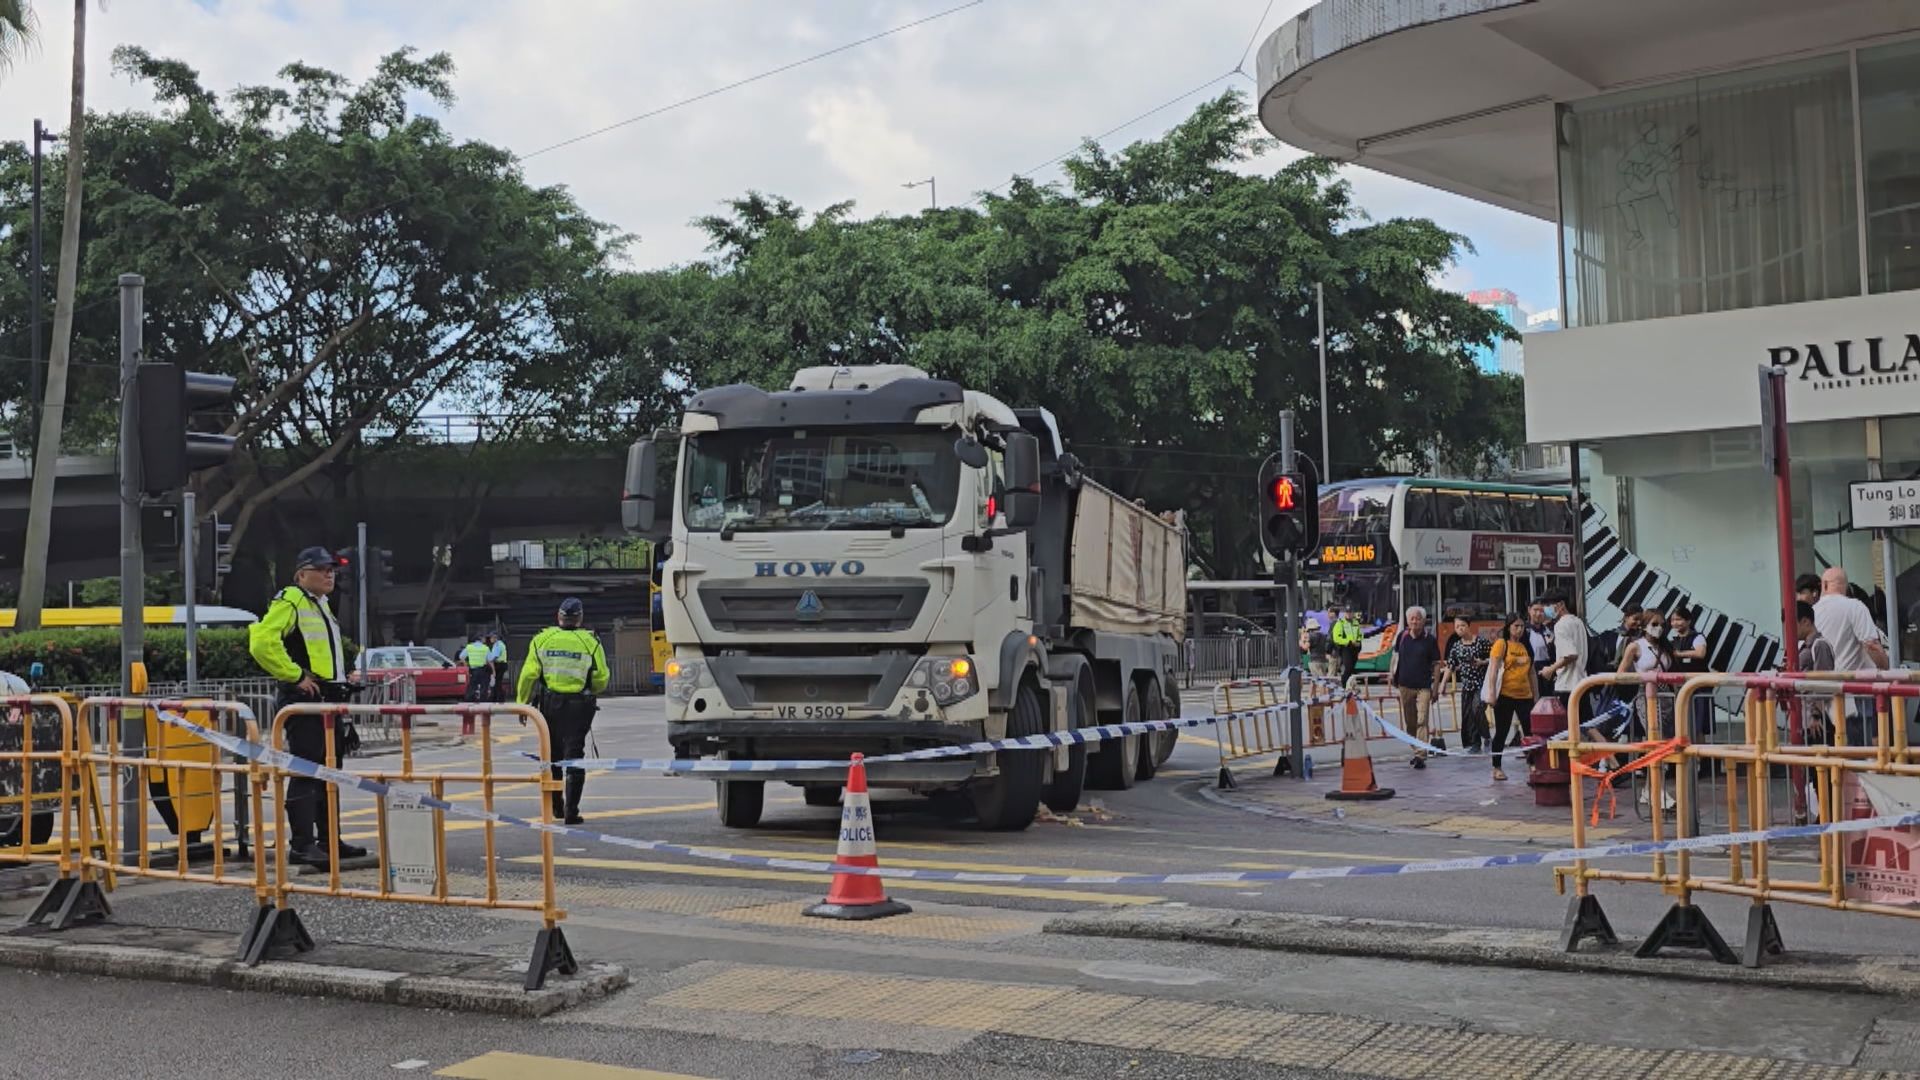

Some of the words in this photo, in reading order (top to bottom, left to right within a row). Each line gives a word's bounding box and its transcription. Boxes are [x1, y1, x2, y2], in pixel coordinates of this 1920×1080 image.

[1857, 488, 1893, 501] Tung
[1898, 486, 1916, 499] Lo
[1358, 544, 1375, 561] 116
[754, 560, 865, 577] HOWO
[777, 706, 797, 718] VR
[804, 706, 845, 719] 9509
[840, 826, 873, 841] OLICE
